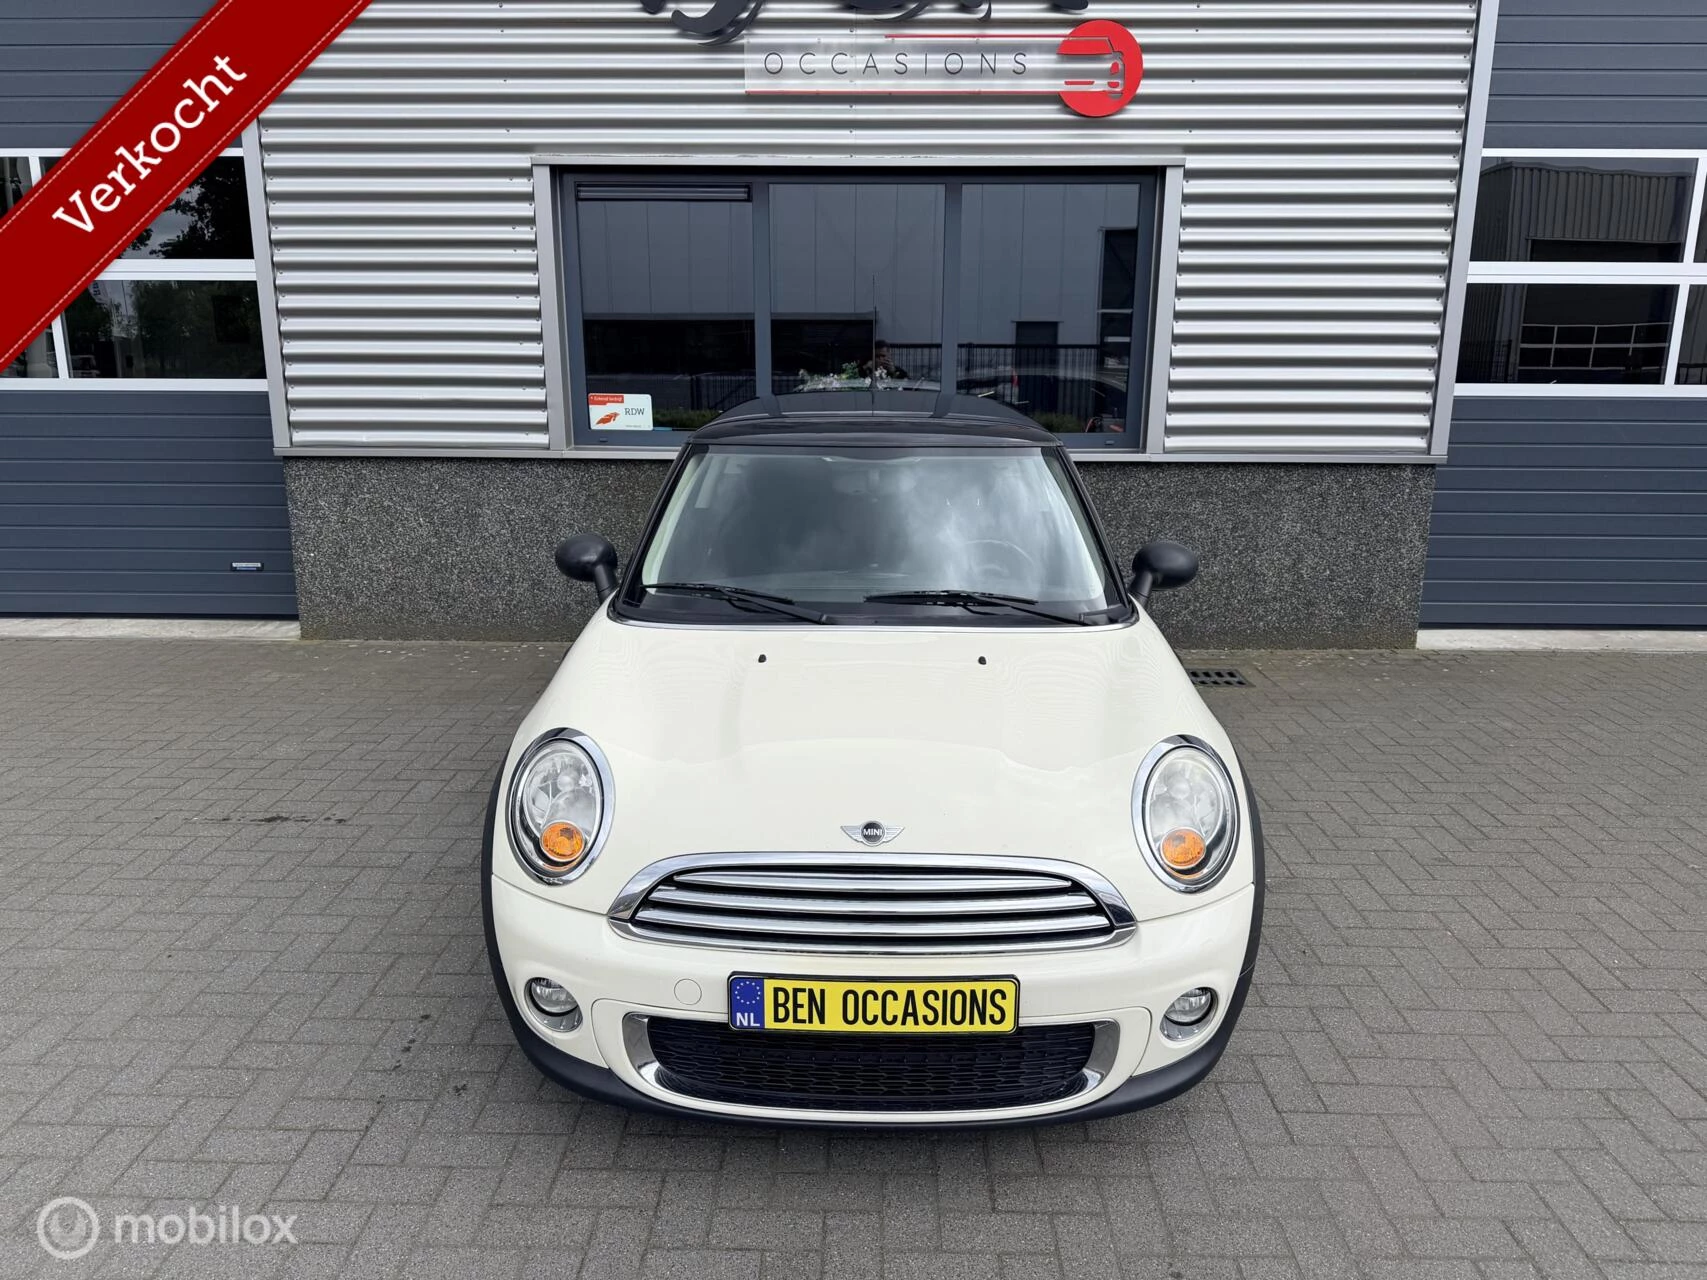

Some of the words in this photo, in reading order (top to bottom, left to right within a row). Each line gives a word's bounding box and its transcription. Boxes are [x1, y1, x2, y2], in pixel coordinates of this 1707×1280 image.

[763, 51, 1029, 76] OCCASIONS
[624, 407, 645, 416] RDW
[863, 828, 883, 836] MINI
[772, 986, 826, 1025] BEN
[842, 988, 1007, 1026] OCCASIONS
[735, 1012, 761, 1027] NL
